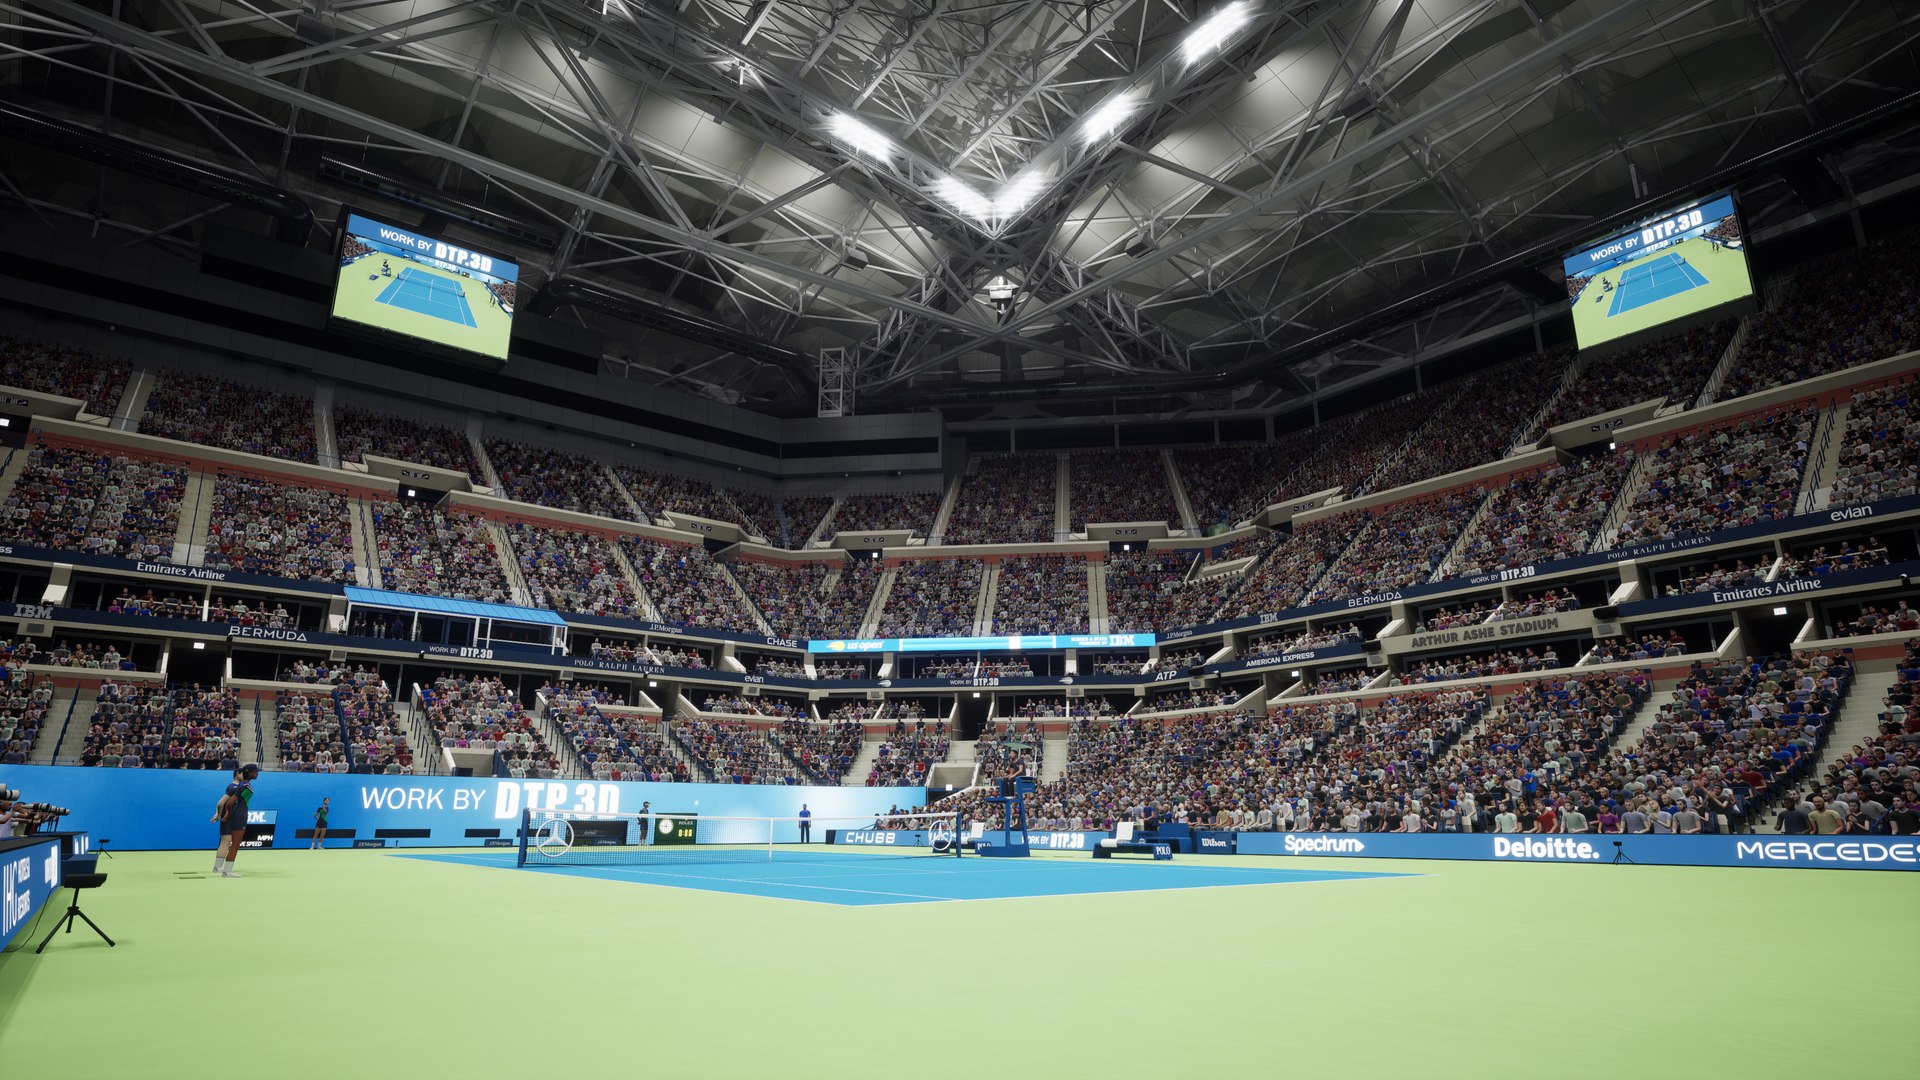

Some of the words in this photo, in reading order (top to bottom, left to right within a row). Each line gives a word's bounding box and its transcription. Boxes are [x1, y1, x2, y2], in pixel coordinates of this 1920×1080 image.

[1590, 243, 1623, 262] WORK
[1625, 236, 1639, 249] BY
[1642, 210, 1703, 245] DTP.3D
[380, 228, 414, 246] WORK
[418, 240, 432, 251] BY
[434, 242, 492, 272] DTP.3D
[1830, 504, 1872, 521] evian
[1607, 551, 1628, 560] POLO
[1633, 544, 1666, 555] RALPH
[1671, 536, 1712, 548] LAUREN
[136, 561, 186, 576] Emirates
[188, 568, 225, 580] Airline
[1470, 576, 1490, 584] WORK
[1500, 566, 1535, 581] DTP.3D
[1713, 586, 1772, 603] Emirates
[1775, 578, 1822, 595] Airline
[1348, 592, 1402, 608] BERMUDA
[14, 604, 54, 619] IBM
[1259, 612, 1278, 624] IBM
[228, 626, 307, 641] BERMUDA
[1412, 632, 1458, 648] ARTHUR
[1463, 627, 1495, 641] ASHE
[1501, 617, 1558, 635] STADIUM
[767, 637, 798, 648] CHASE
[859, 642, 883, 651] open
[1109, 635, 1134, 646] IBM
[460, 647, 493, 659] DTP.3D
[1245, 656, 1281, 668] AMERICAN
[1282, 651, 1315, 662] EXPRESS
[574, 659, 594, 667] POLO
[599, 662, 627, 670] RALPH
[632, 665, 665, 674] LAUREN
[744, 675, 764, 684] evian
[1154, 670, 1177, 682] ATP
[361, 787, 444, 810] WORK
[452, 789, 486, 810] BY
[846, 832, 895, 844] CHUBB
[1041, 836, 1049, 844] BY
[1050, 832, 1084, 848] DTP.3D
[1202, 838, 1227, 847] Wilson
[1285, 835, 1359, 855] Spectrum
[1156, 846, 1170, 855] POLO
